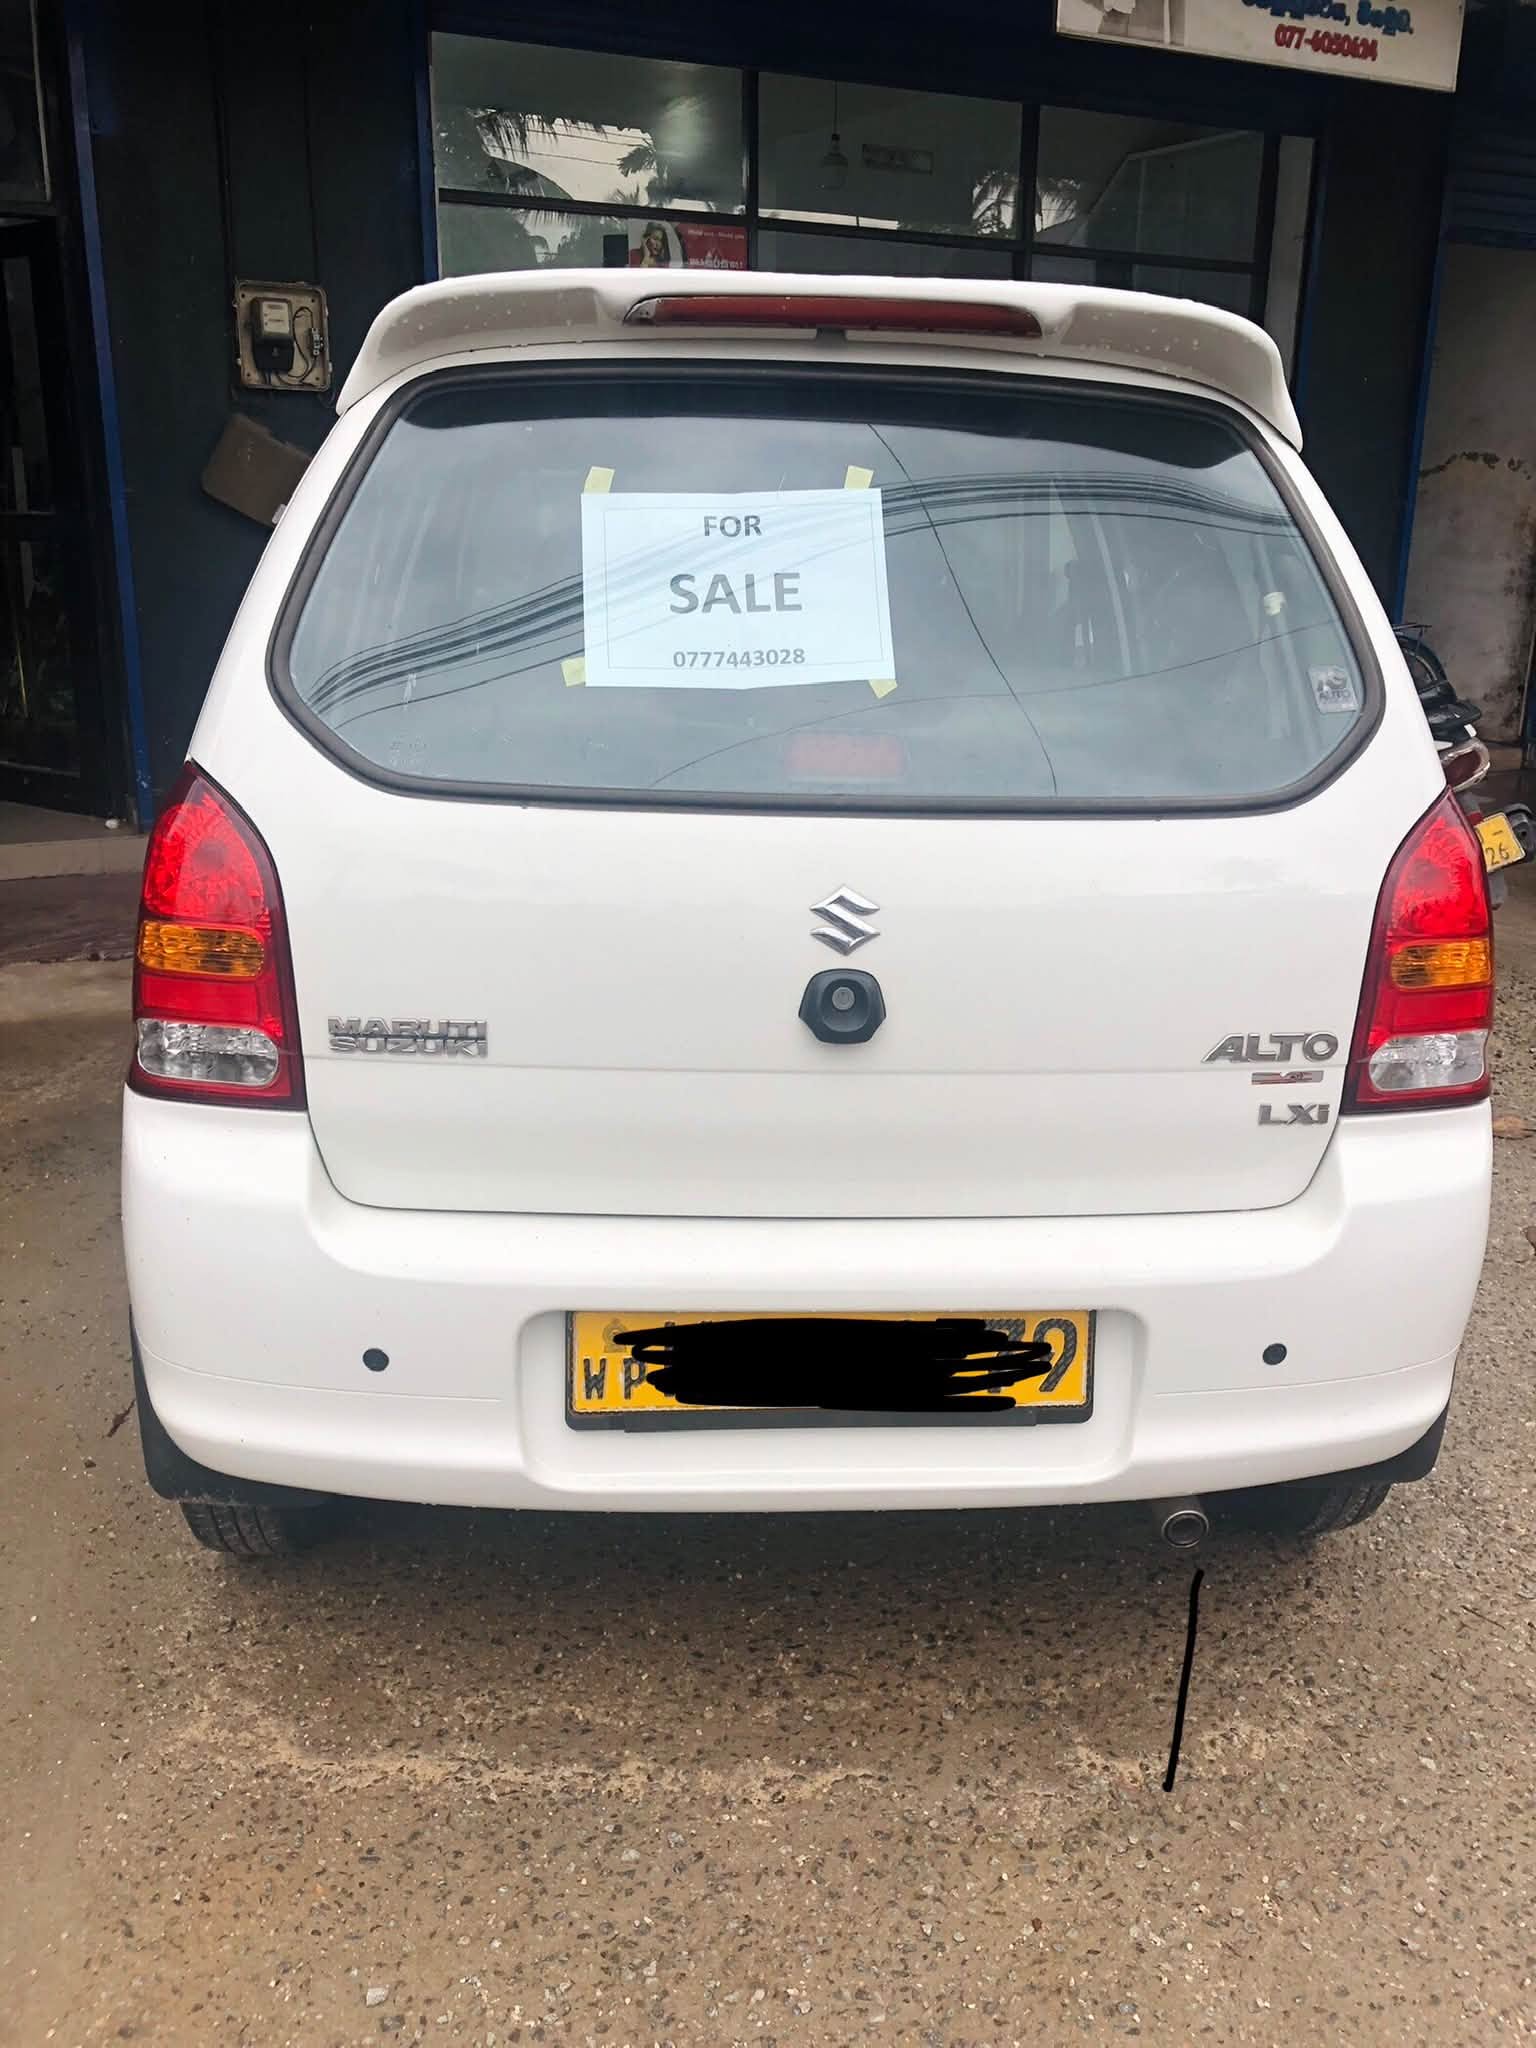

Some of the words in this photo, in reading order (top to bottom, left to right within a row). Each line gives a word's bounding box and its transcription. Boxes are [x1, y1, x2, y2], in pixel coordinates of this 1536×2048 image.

[703, 515, 762, 537] FOR
[669, 572, 802, 614] SALE
[673, 648, 805, 668] 0777443028
[328, 1016, 487, 1039] MARUTI
[328, 1036, 488, 1058] SUZUKI
[1201, 1031, 1339, 1064] ALTO
